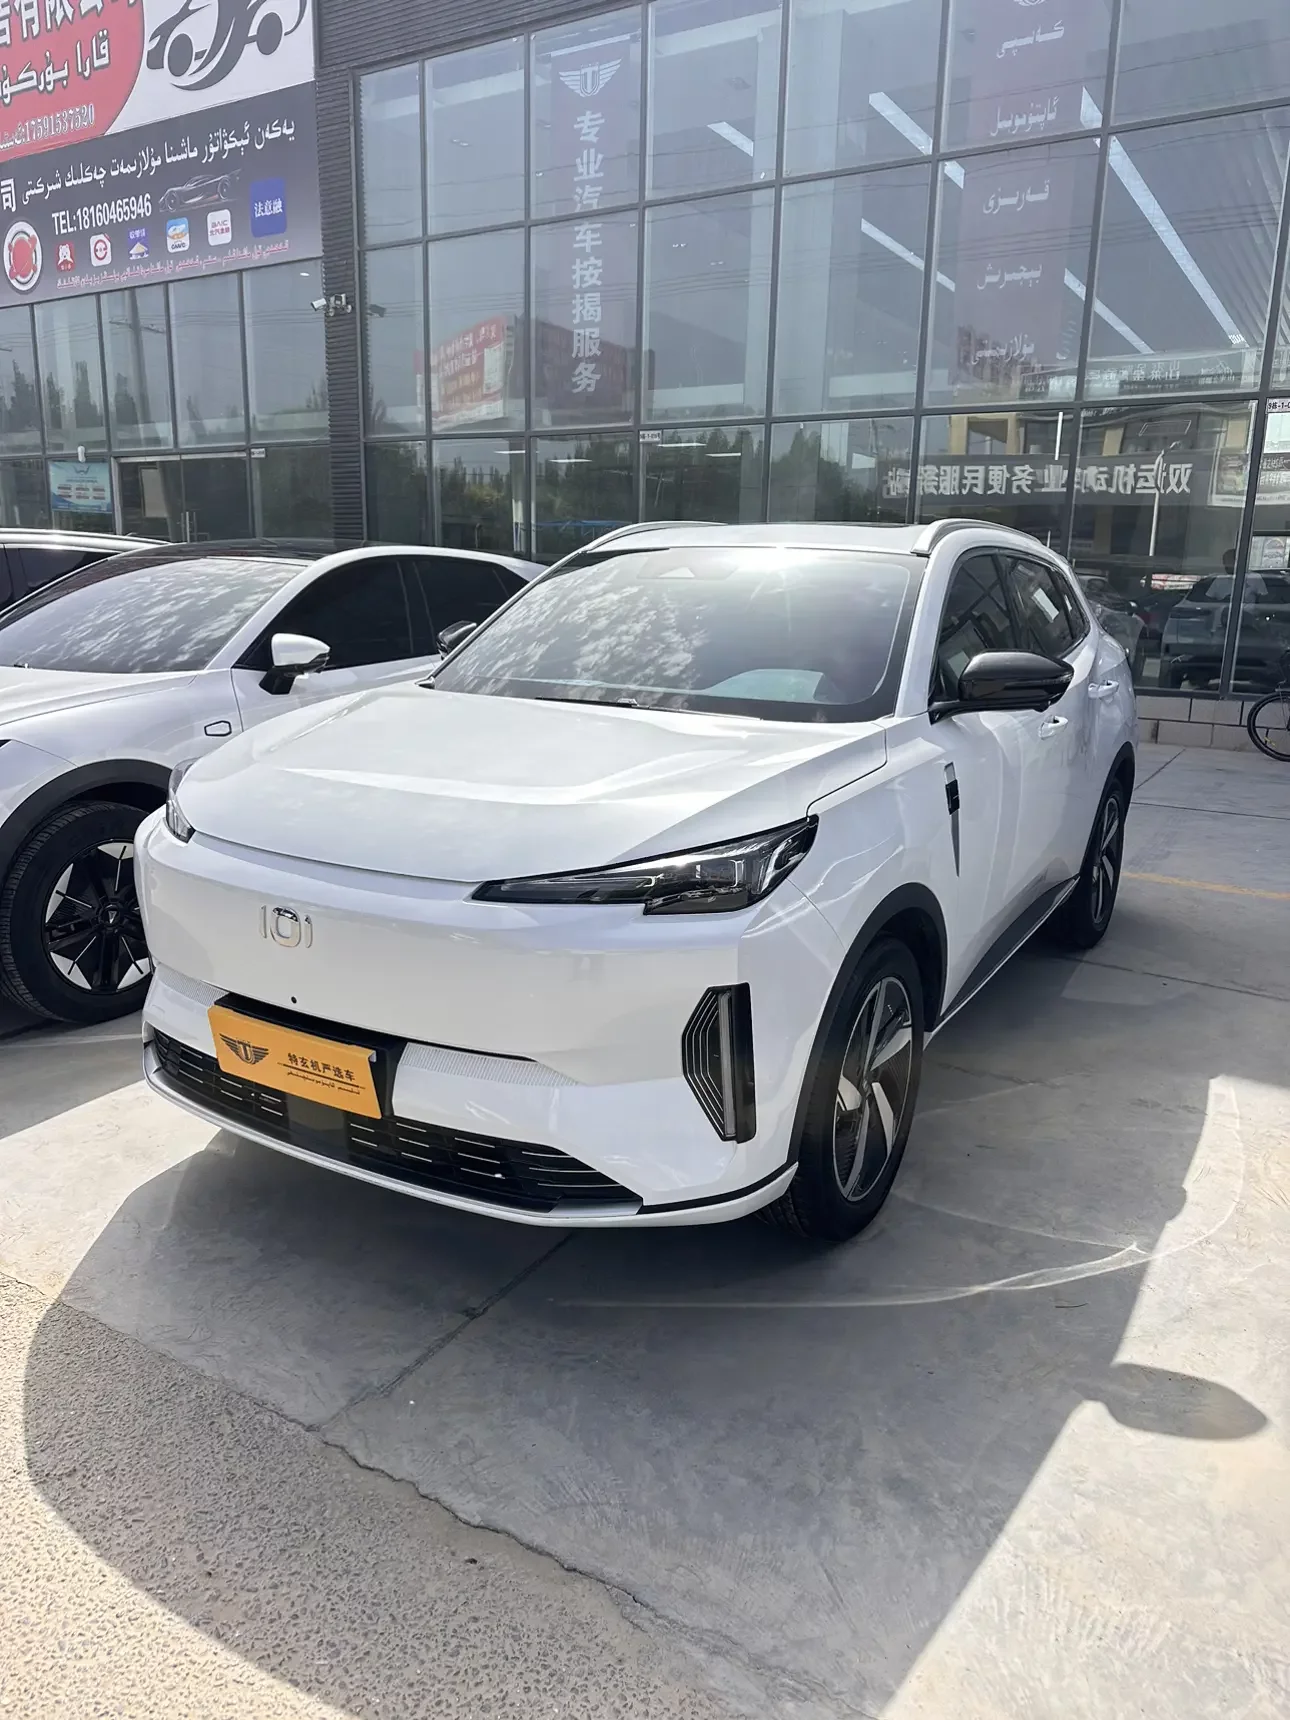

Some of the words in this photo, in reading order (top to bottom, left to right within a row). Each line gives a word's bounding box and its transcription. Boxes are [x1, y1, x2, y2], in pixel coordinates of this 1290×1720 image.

[0, 178, 16, 212] 司
[52, 193, 152, 235] TEL:18160465946
[572, 110, 605, 394] 专业汽车按揭服务
